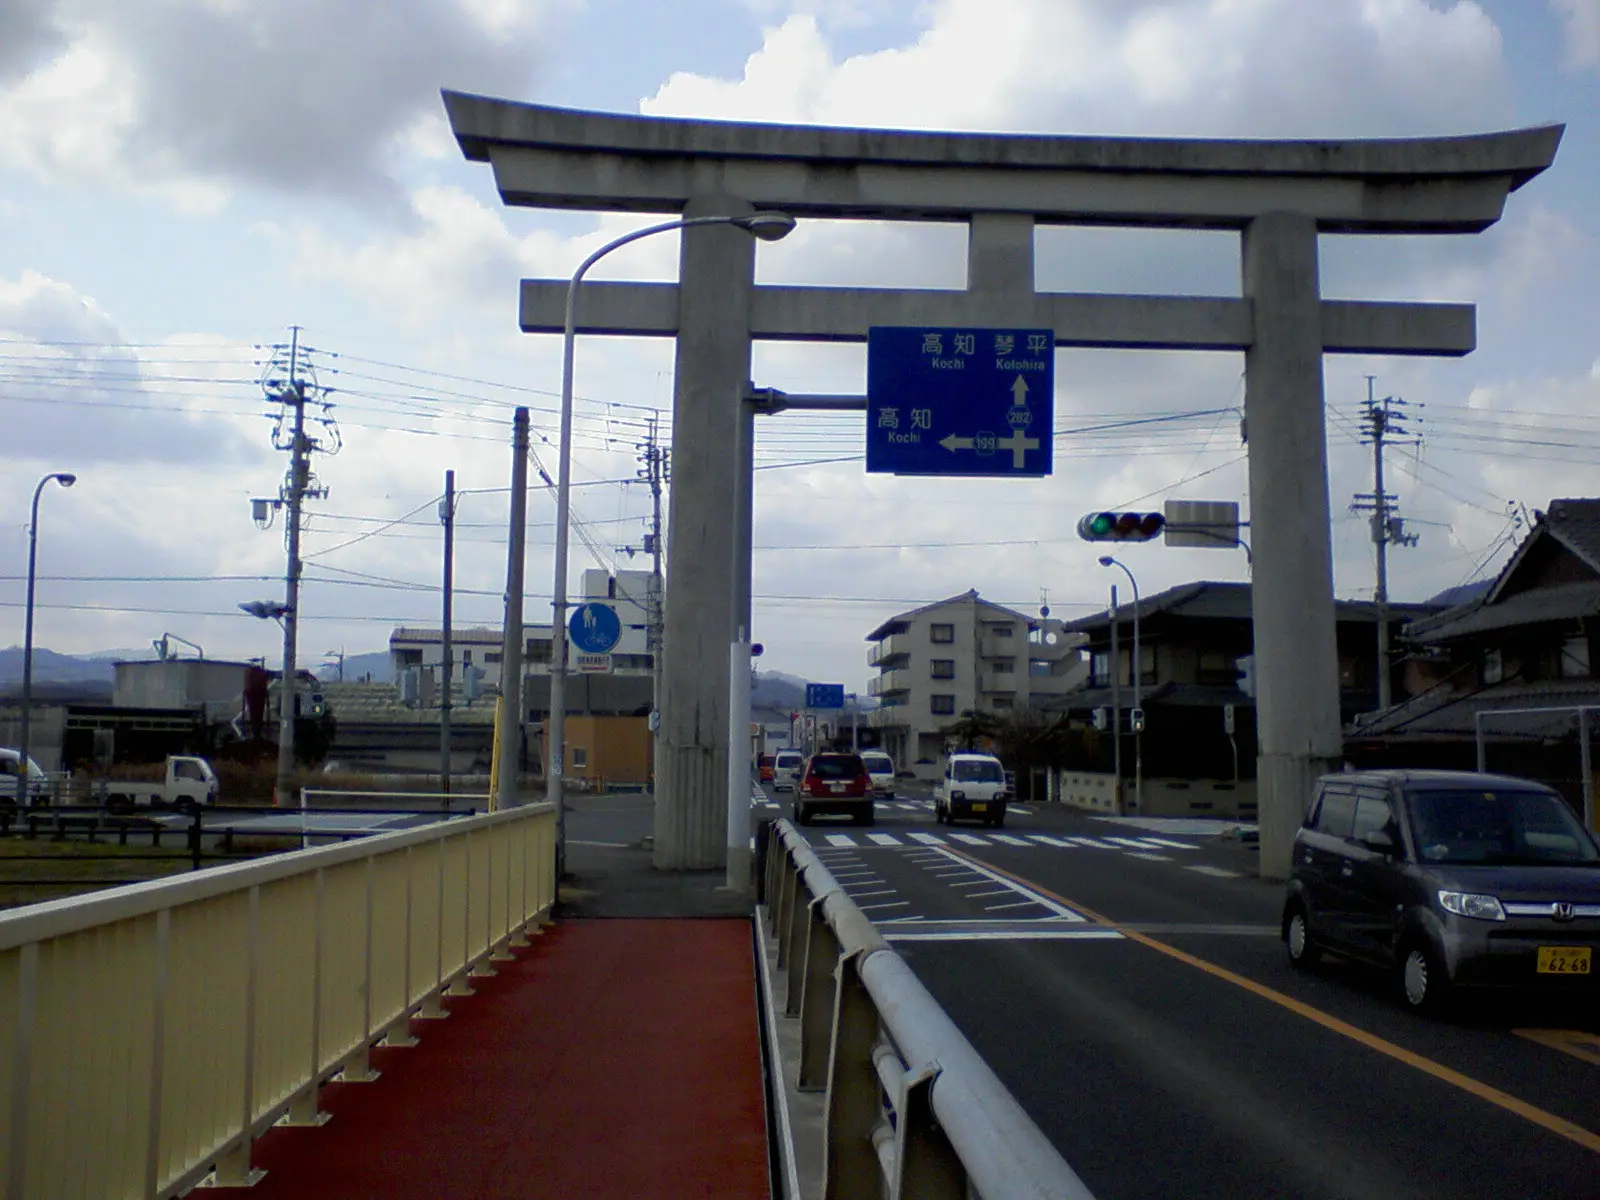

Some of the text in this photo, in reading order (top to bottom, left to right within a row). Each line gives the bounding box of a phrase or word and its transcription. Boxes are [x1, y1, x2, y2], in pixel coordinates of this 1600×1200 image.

[922, 333, 975, 355] 高知
[932, 357, 1045, 370] Kochi Kotohira
[878, 407, 932, 429] 高知
[888, 431, 921, 443] Kochi
[1549, 958, 1588, 971] 62-68
